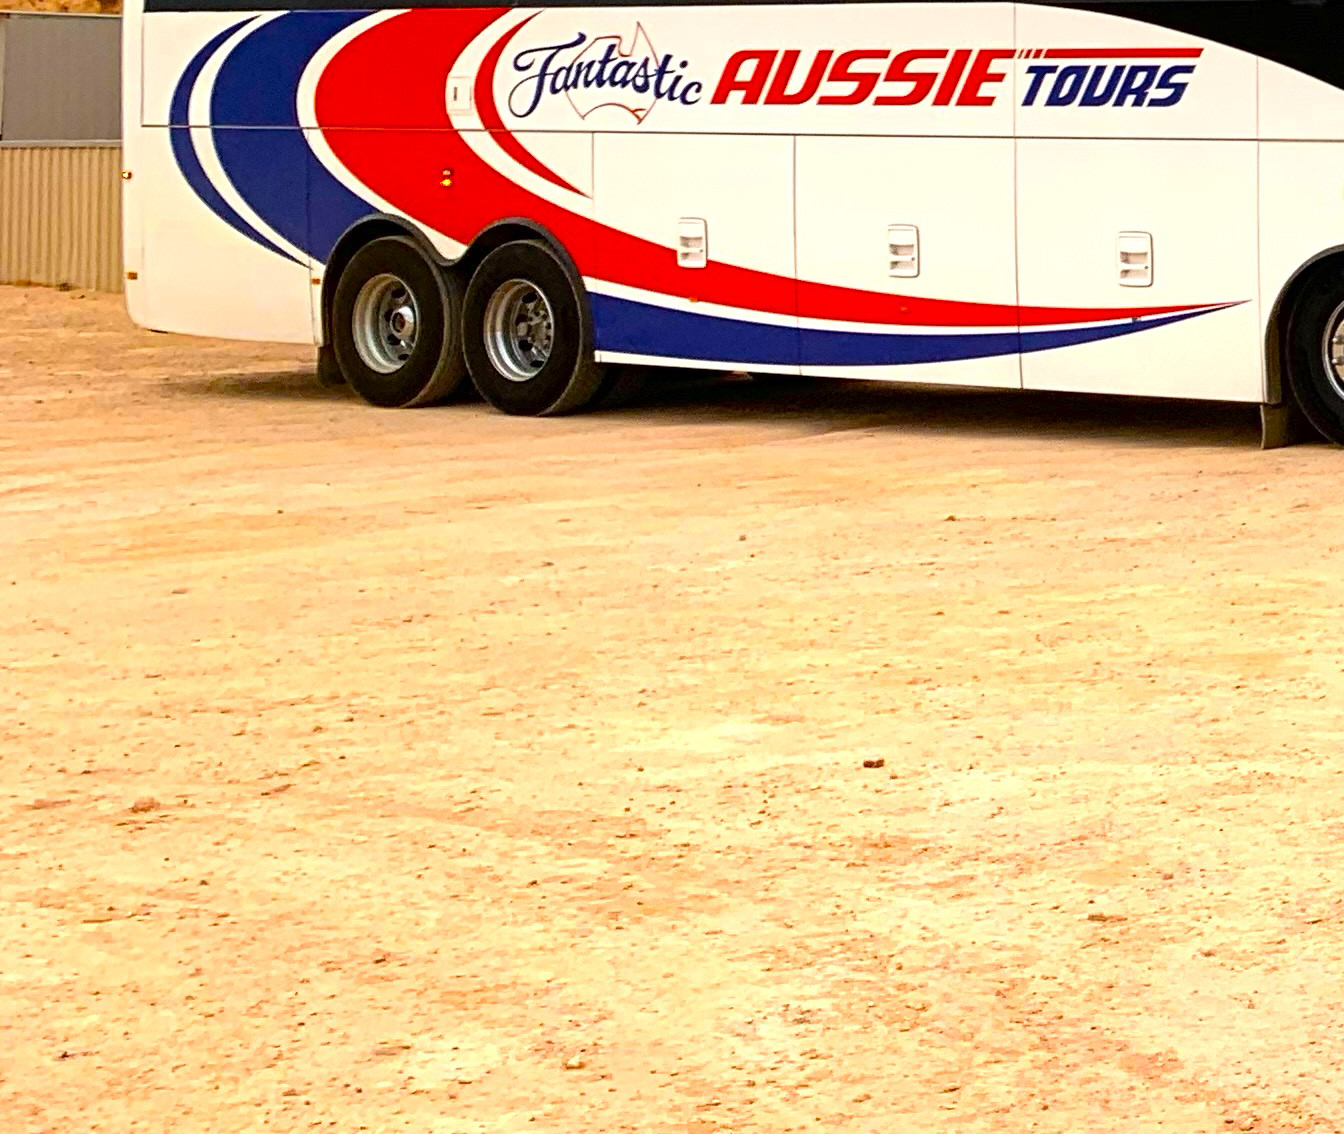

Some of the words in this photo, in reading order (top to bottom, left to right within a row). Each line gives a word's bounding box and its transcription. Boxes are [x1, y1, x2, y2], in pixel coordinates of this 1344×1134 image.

[509, 32, 702, 119] Fantastic
[709, 48, 1008, 106] AUSSIE
[1021, 64, 1197, 108] TOURS
